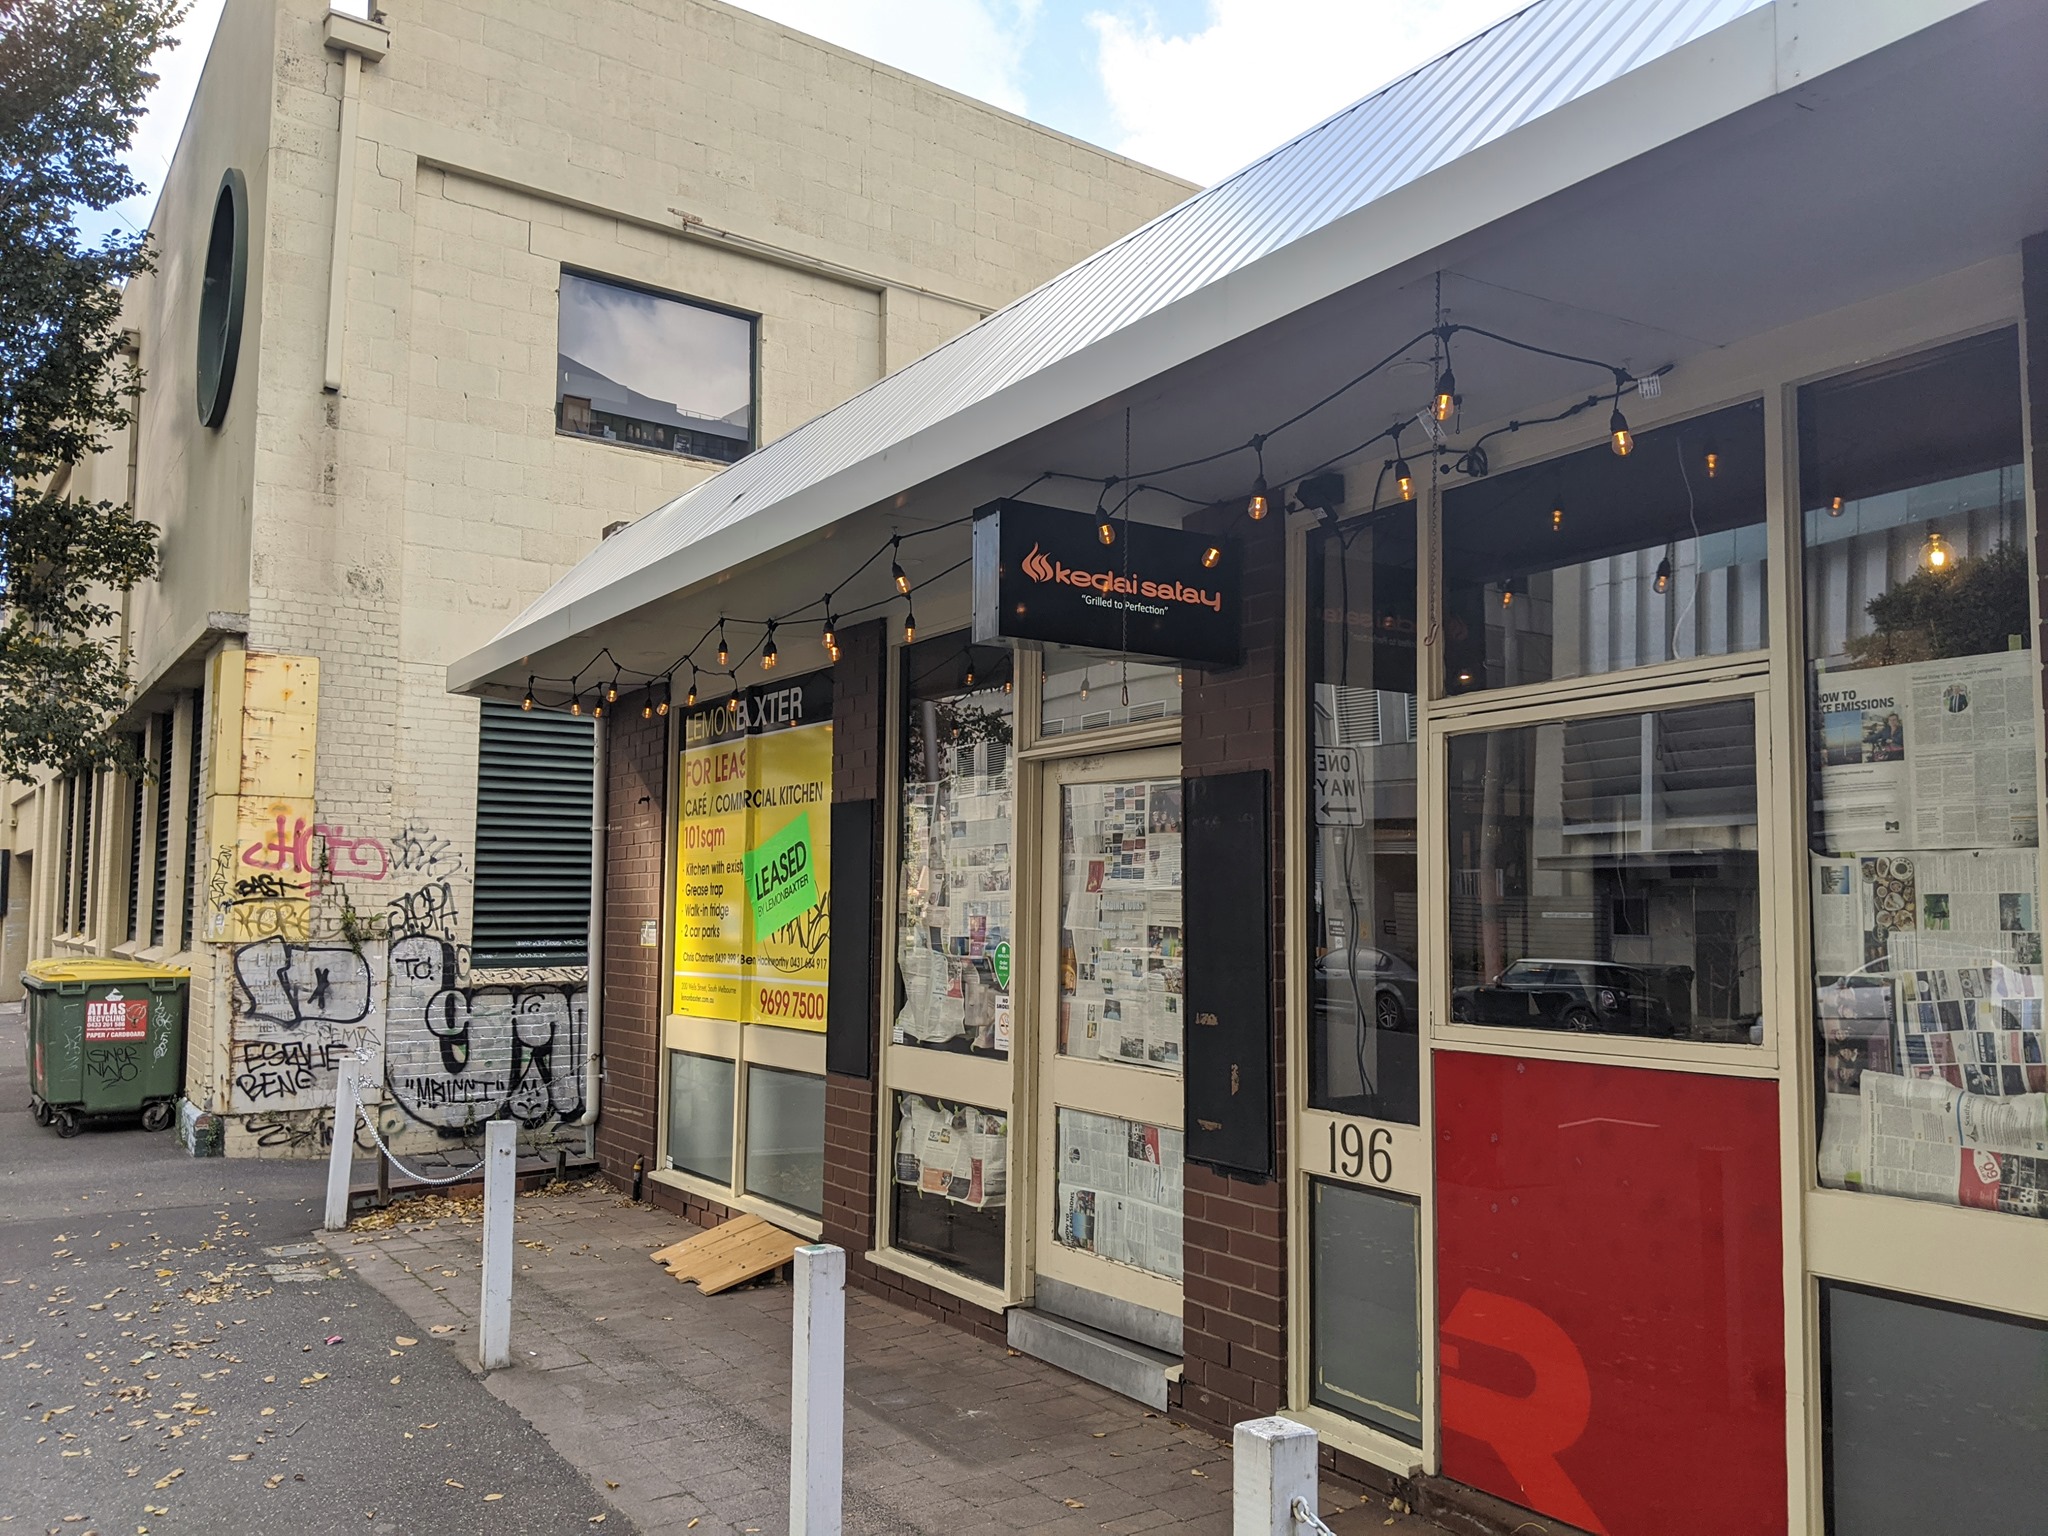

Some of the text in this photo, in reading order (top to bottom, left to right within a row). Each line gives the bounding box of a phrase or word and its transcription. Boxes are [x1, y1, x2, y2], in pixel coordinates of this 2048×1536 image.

[1055, 561, 1221, 612] kedai satay
[1114, 600, 1123, 610] to
[1842, 689, 1857, 701] TO
[1834, 697, 1895, 712] EMISSIONS
[685, 757, 711, 787] FOR
[685, 792, 707, 817] CAFÉ
[779, 781, 823, 806] KITCHEN
[684, 825, 725, 852] 101sqm
[685, 862, 709, 876] Kitchen
[711, 861, 725, 874] with
[755, 842, 807, 901] LEASED
[685, 883, 724, 899] Grease trap
[685, 903, 730, 920] Walk-in fridge
[684, 924, 720, 940] 2 car parks
[88, 1002, 126, 1016] ATLAS
[760, 987, 825, 1021] 9699 7500
[87, 1014, 126, 1023] RECYCLING
[1328, 1120, 1393, 1183] 196
